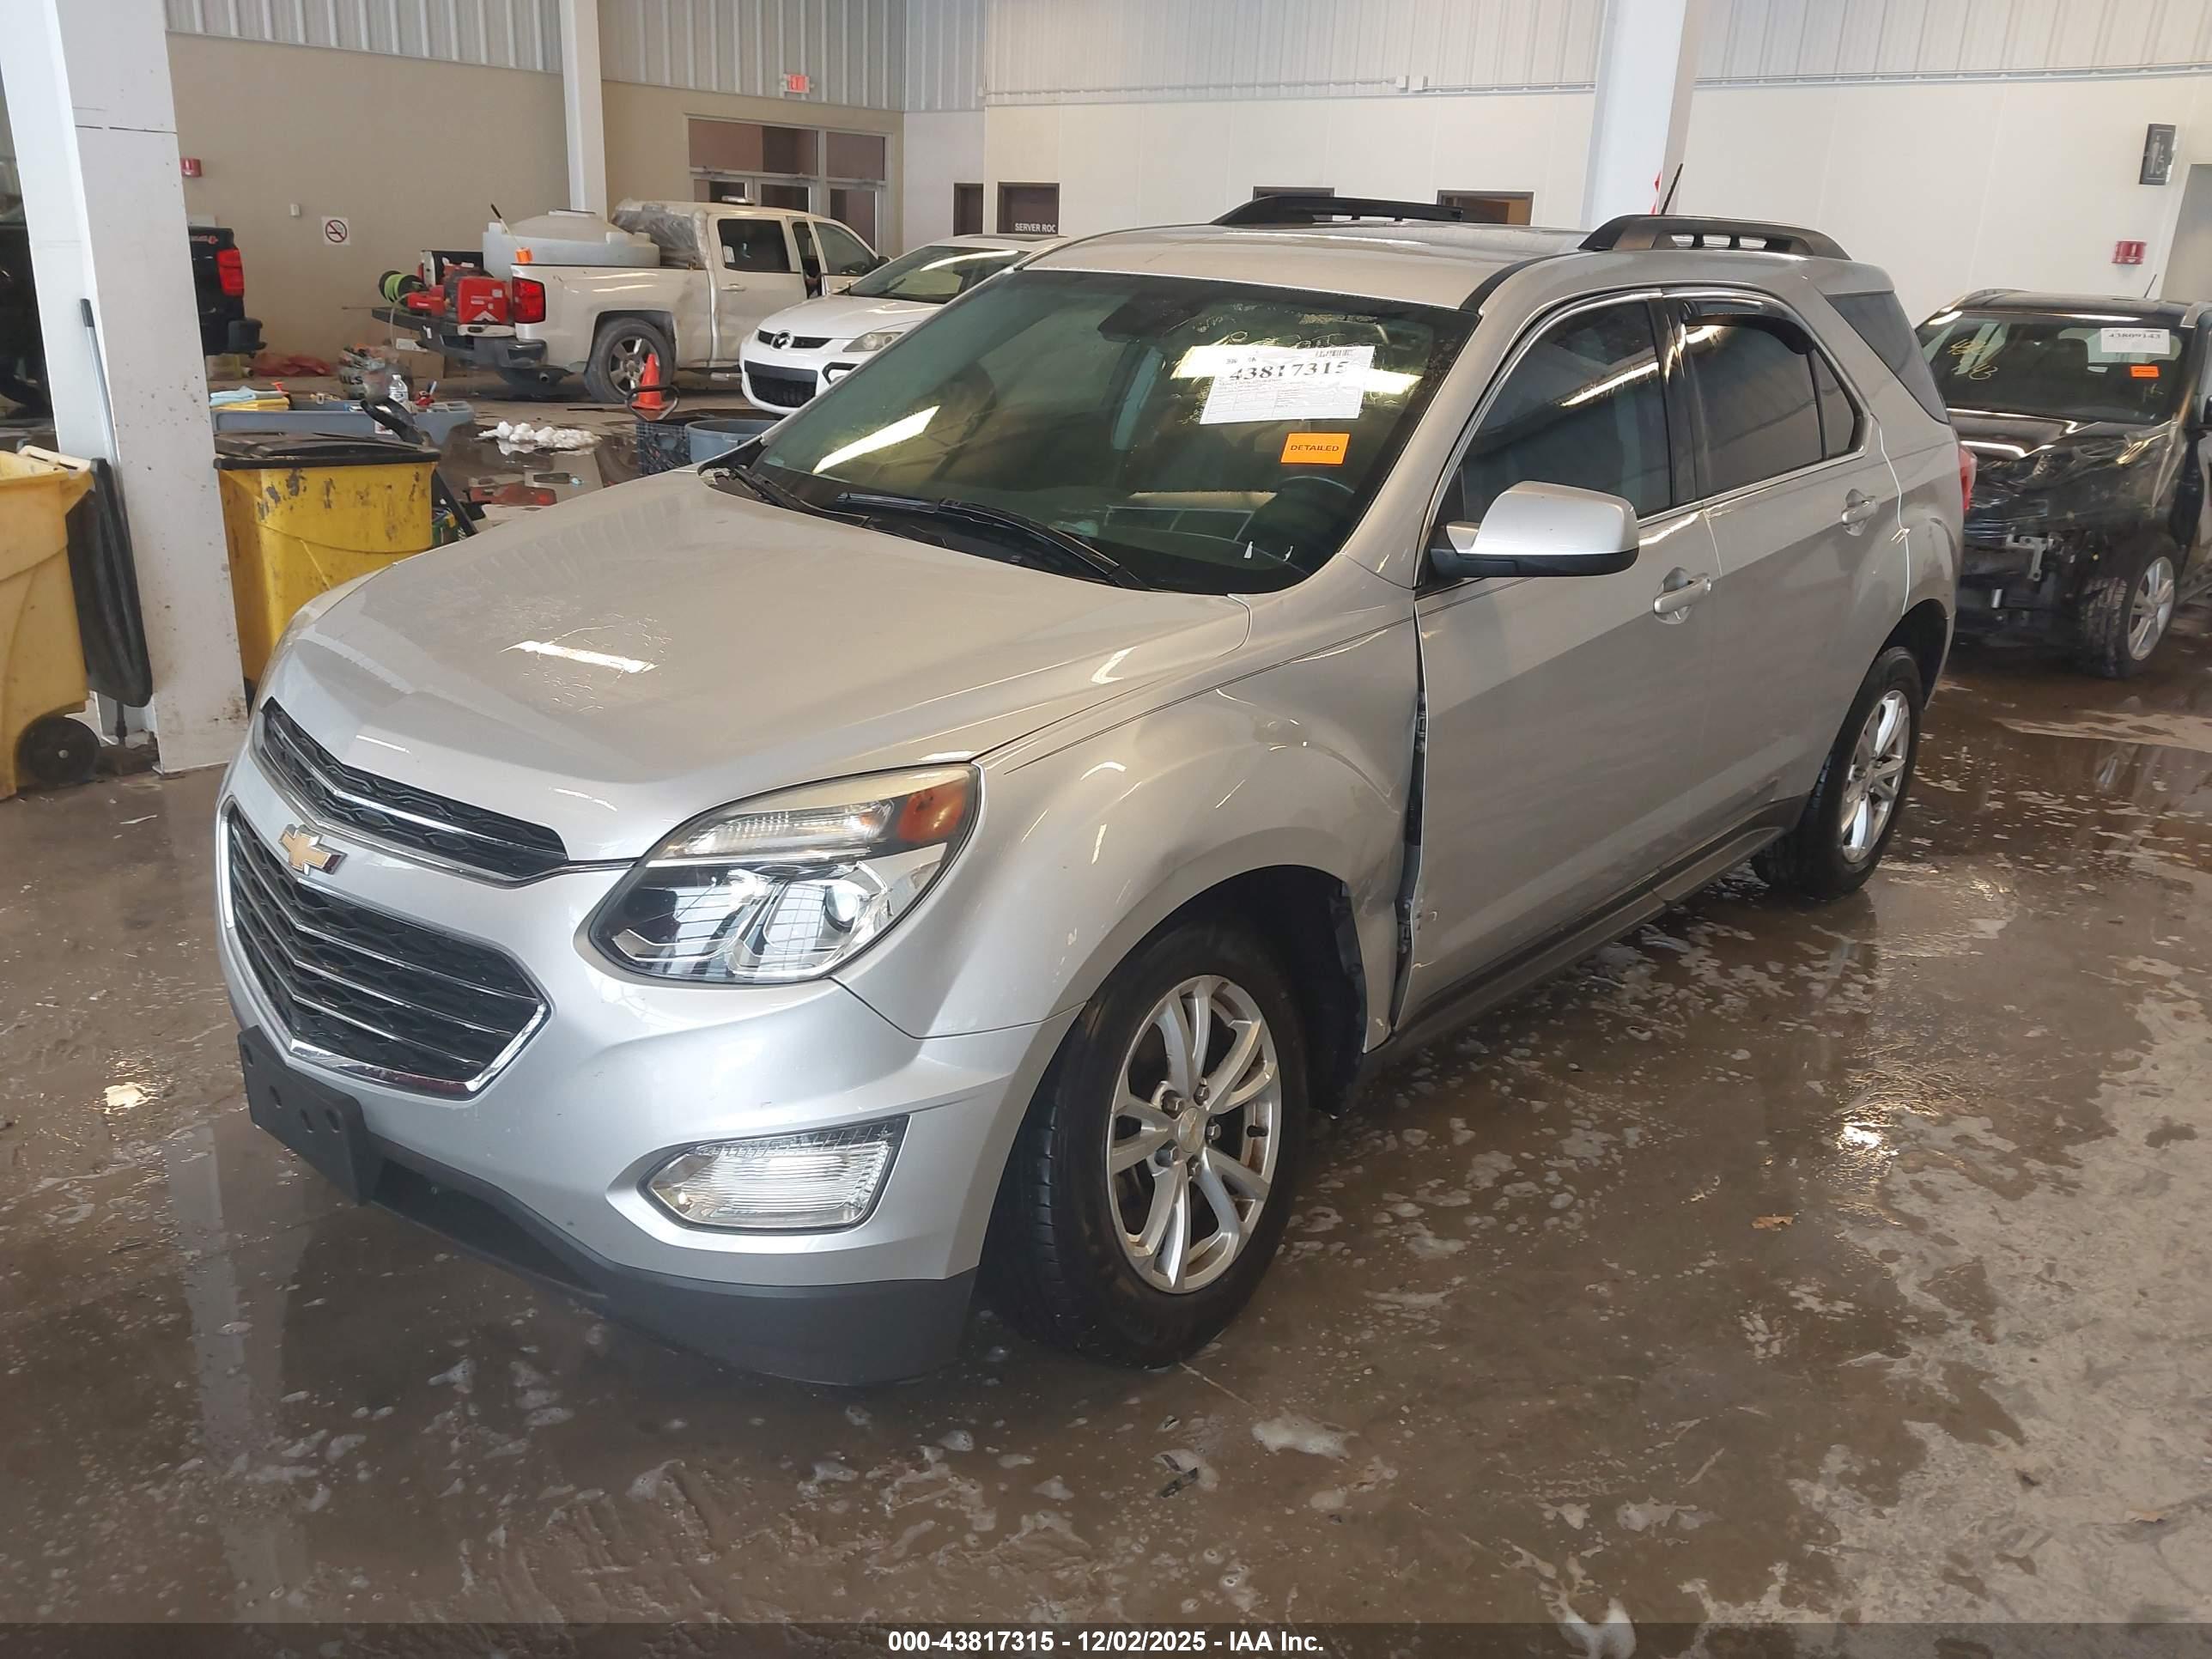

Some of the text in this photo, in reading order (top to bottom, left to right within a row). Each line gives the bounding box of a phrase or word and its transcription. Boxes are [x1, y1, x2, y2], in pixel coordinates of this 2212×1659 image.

[1015, 222, 1041, 232] SERVER
[1230, 361, 1351, 381] 43817315
[1290, 443, 1340, 453] DETAILED
